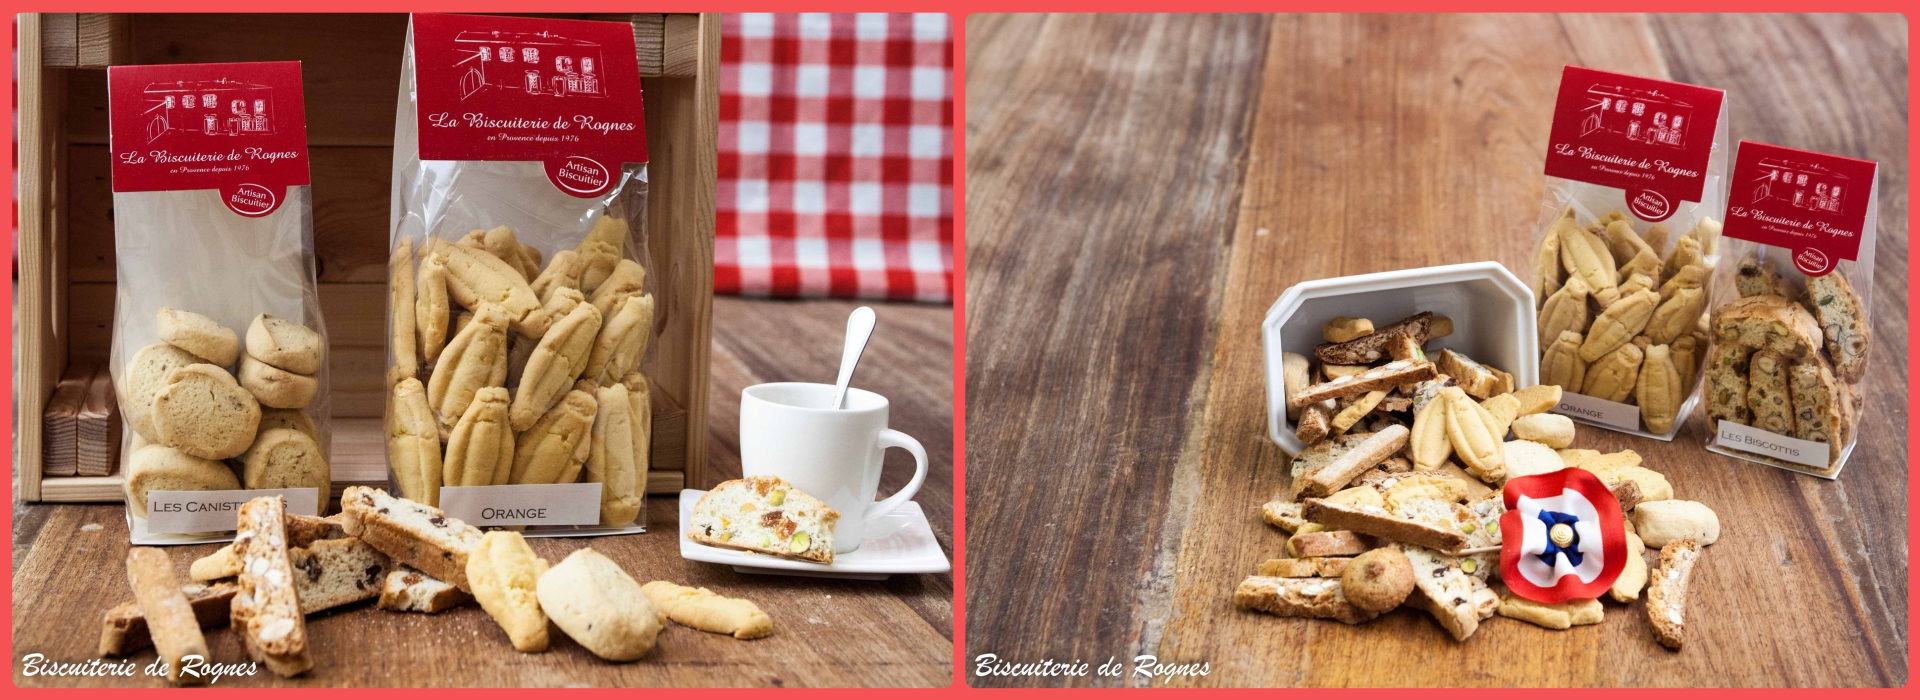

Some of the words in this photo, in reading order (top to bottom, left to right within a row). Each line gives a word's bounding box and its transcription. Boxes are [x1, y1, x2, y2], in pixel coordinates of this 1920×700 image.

[428, 112, 459, 128] La
[463, 113, 551, 130] Biscuiterie
[552, 116, 570, 130] de
[573, 115, 636, 135] Rognes
[498, 133, 534, 142] Provence
[535, 134, 559, 144] depuis
[120, 150, 147, 164] La
[150, 150, 224, 164] Biscuiterie
[224, 148, 243, 161] de
[244, 147, 300, 163] Rognes
[1555, 143, 1576, 156] La
[1578, 146, 1639, 167] Biscuiterie
[1638, 158, 1652, 169] de
[1654, 160, 1699, 178] Rognes
[179, 166, 211, 174] Provence
[211, 165, 232, 174] depuis
[233, 164, 250, 172] 1976
[565, 160, 599, 176] Artisan
[558, 168, 604, 187] Biscuitier
[231, 194, 271, 209] Biscuitier
[237, 187, 267, 200] Artisan
[1639, 192, 1664, 207] Artisan
[1633, 196, 1665, 216] Biscuitier
[1731, 206, 1749, 218] La
[1751, 209, 1802, 228] Biscuiterie
[1802, 220, 1815, 230] de
[1816, 220, 1855, 238] Rognes
[1797, 253, 1825, 271] Biscuitier
[1803, 249, 1824, 263] Artisan
[1560, 403, 1604, 419] ORANGE
[1721, 430, 1743, 443] LES
[1744, 435, 1800, 456] BISCOTTIS
[153, 501, 182, 513] LES
[481, 507, 547, 520] ORANGE
